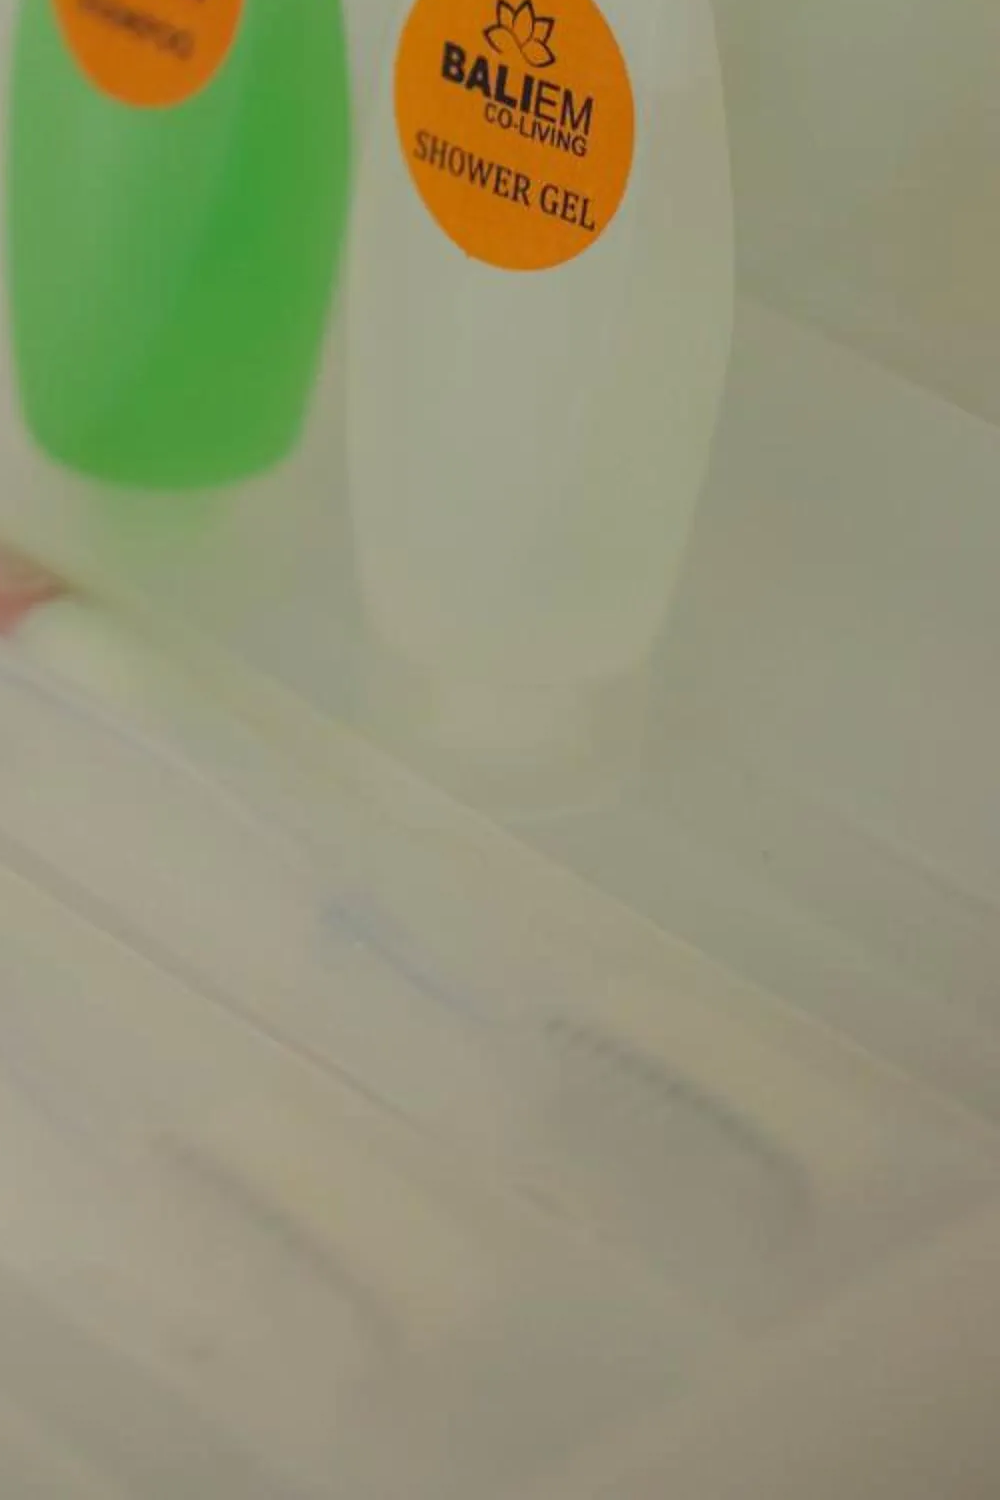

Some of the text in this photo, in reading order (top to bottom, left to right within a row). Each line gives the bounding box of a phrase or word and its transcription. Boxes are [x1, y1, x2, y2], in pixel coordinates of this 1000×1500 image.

[442, 41, 594, 135] BALIEM
[484, 102, 588, 158] CO-LIVING
[414, 129, 596, 232] SHOWER GEL
